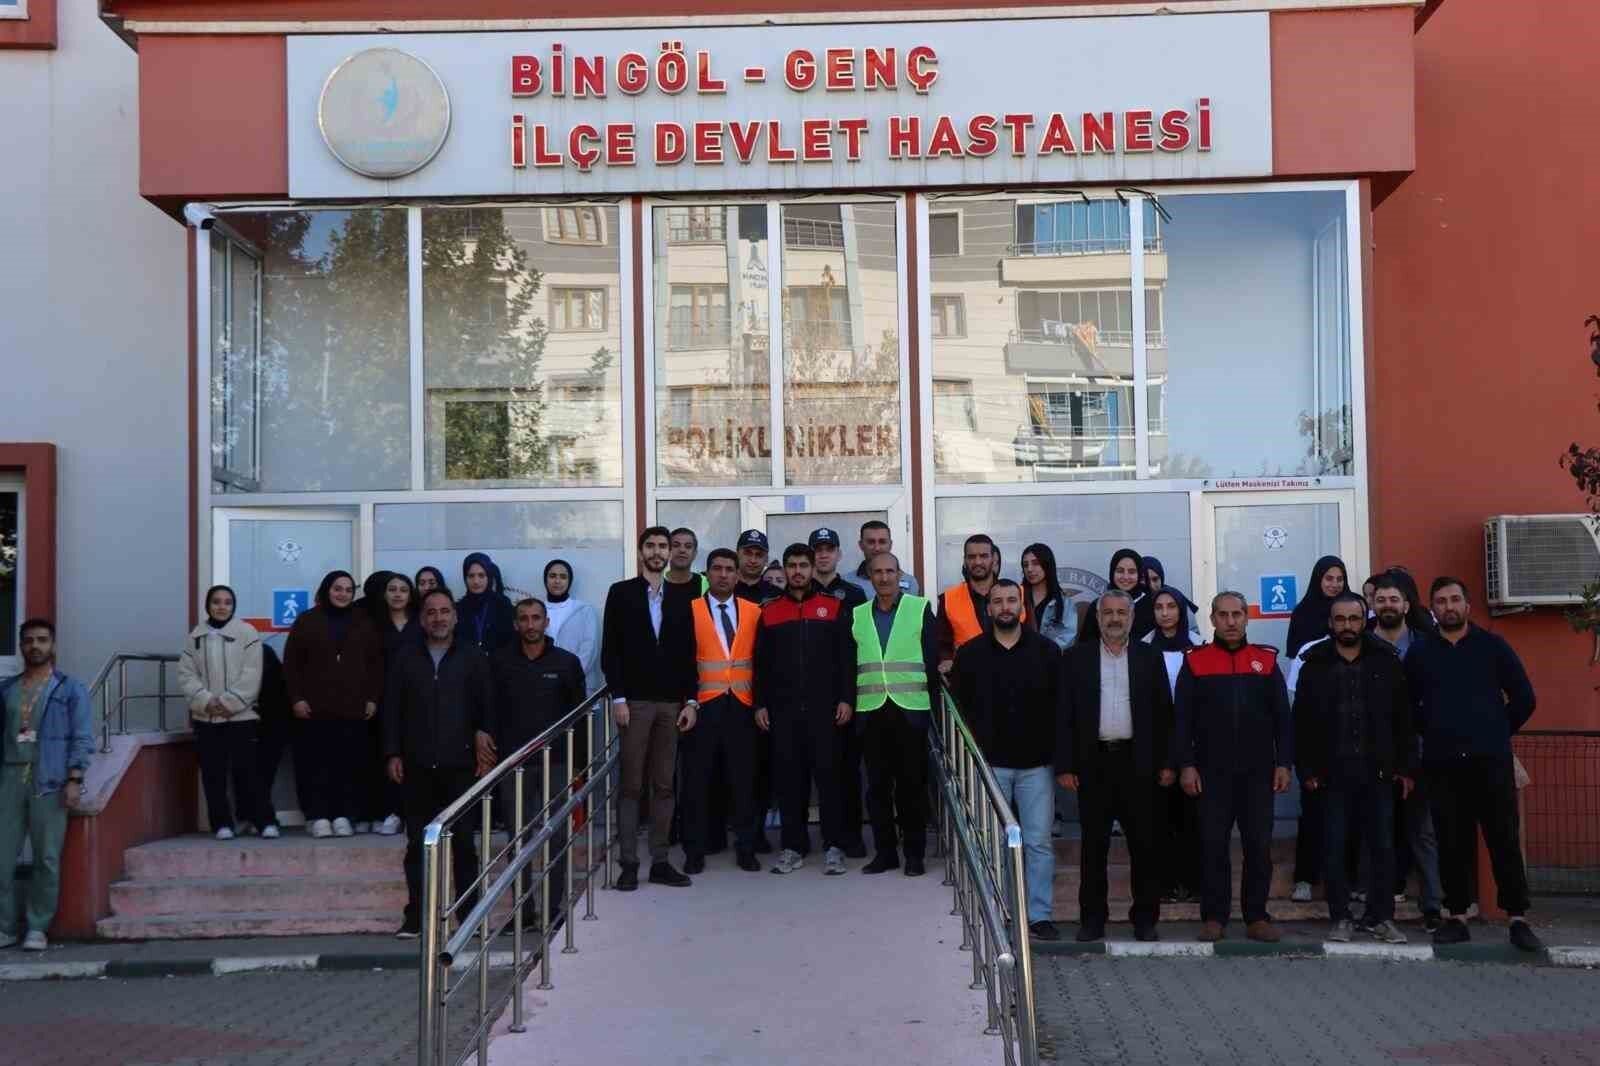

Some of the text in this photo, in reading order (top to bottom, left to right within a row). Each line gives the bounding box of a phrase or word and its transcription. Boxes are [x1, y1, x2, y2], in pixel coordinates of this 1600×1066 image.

[511, 40, 727, 97] BİNGÖL
[784, 46, 939, 95] GENÇ
[511, 97, 1212, 172] İLÇE DEVLET HASTANESİ
